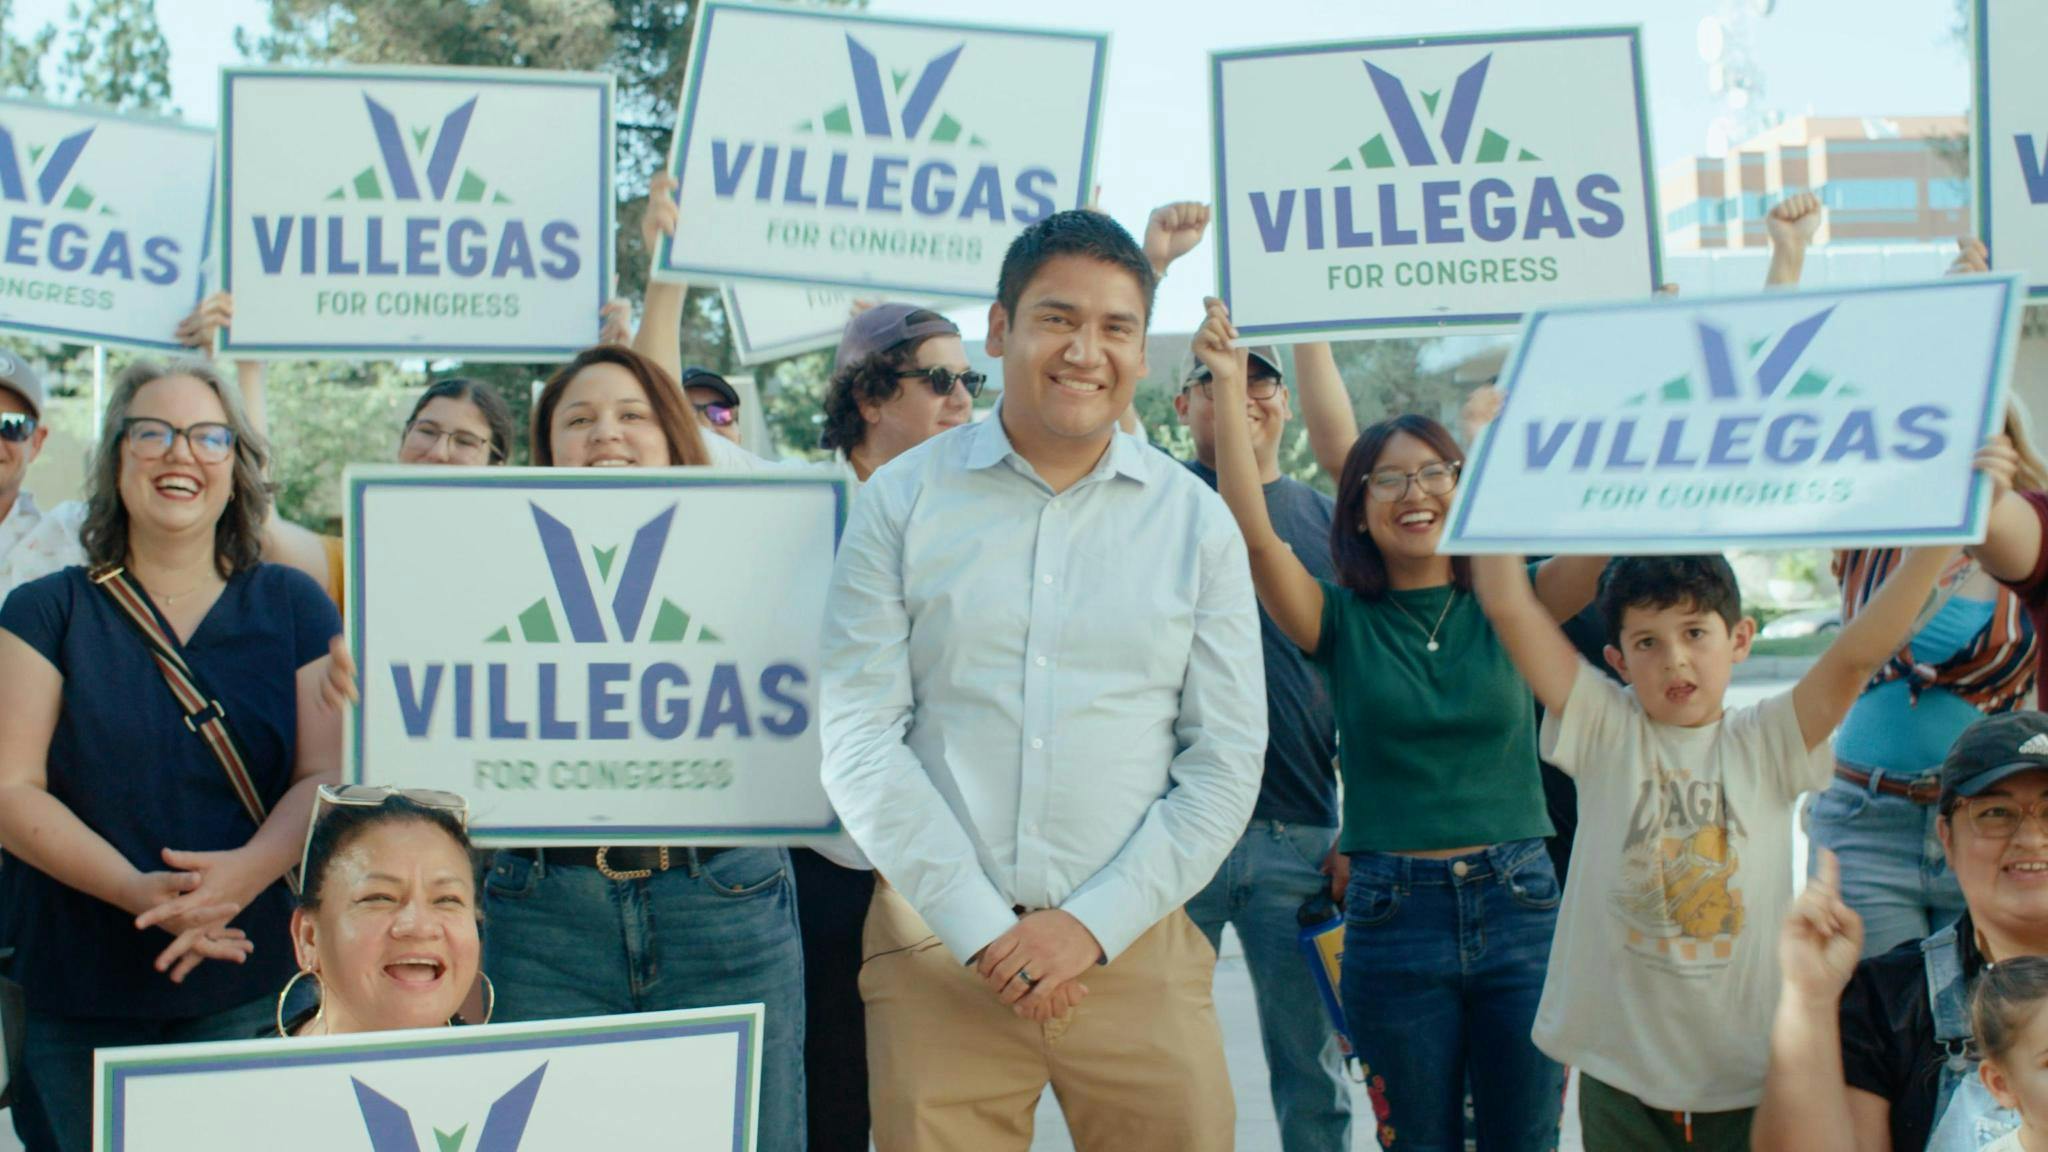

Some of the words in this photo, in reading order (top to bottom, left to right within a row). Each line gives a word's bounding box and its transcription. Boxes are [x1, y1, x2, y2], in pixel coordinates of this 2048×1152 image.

[709, 138, 1058, 224] VILLEGAS
[1247, 173, 1625, 254] VILLEGAS
[4, 215, 182, 286] EGAS
[251, 215, 582, 281] VILLEGAS
[766, 219, 820, 248] FOR
[829, 223, 984, 263] CONGRESS
[1327, 263, 1384, 291] FOR
[1394, 256, 1559, 287] CONGRESS
[316, 291, 367, 317] FOR
[376, 291, 521, 318] CONGRESS
[1523, 404, 1949, 472] VILLEGAS
[1581, 485, 1644, 511] FOR
[1657, 477, 1856, 509] CONGRESS
[389, 661, 811, 741] VILLEGAS
[473, 759, 539, 791] FOR
[549, 758, 735, 791] CONGRESS
